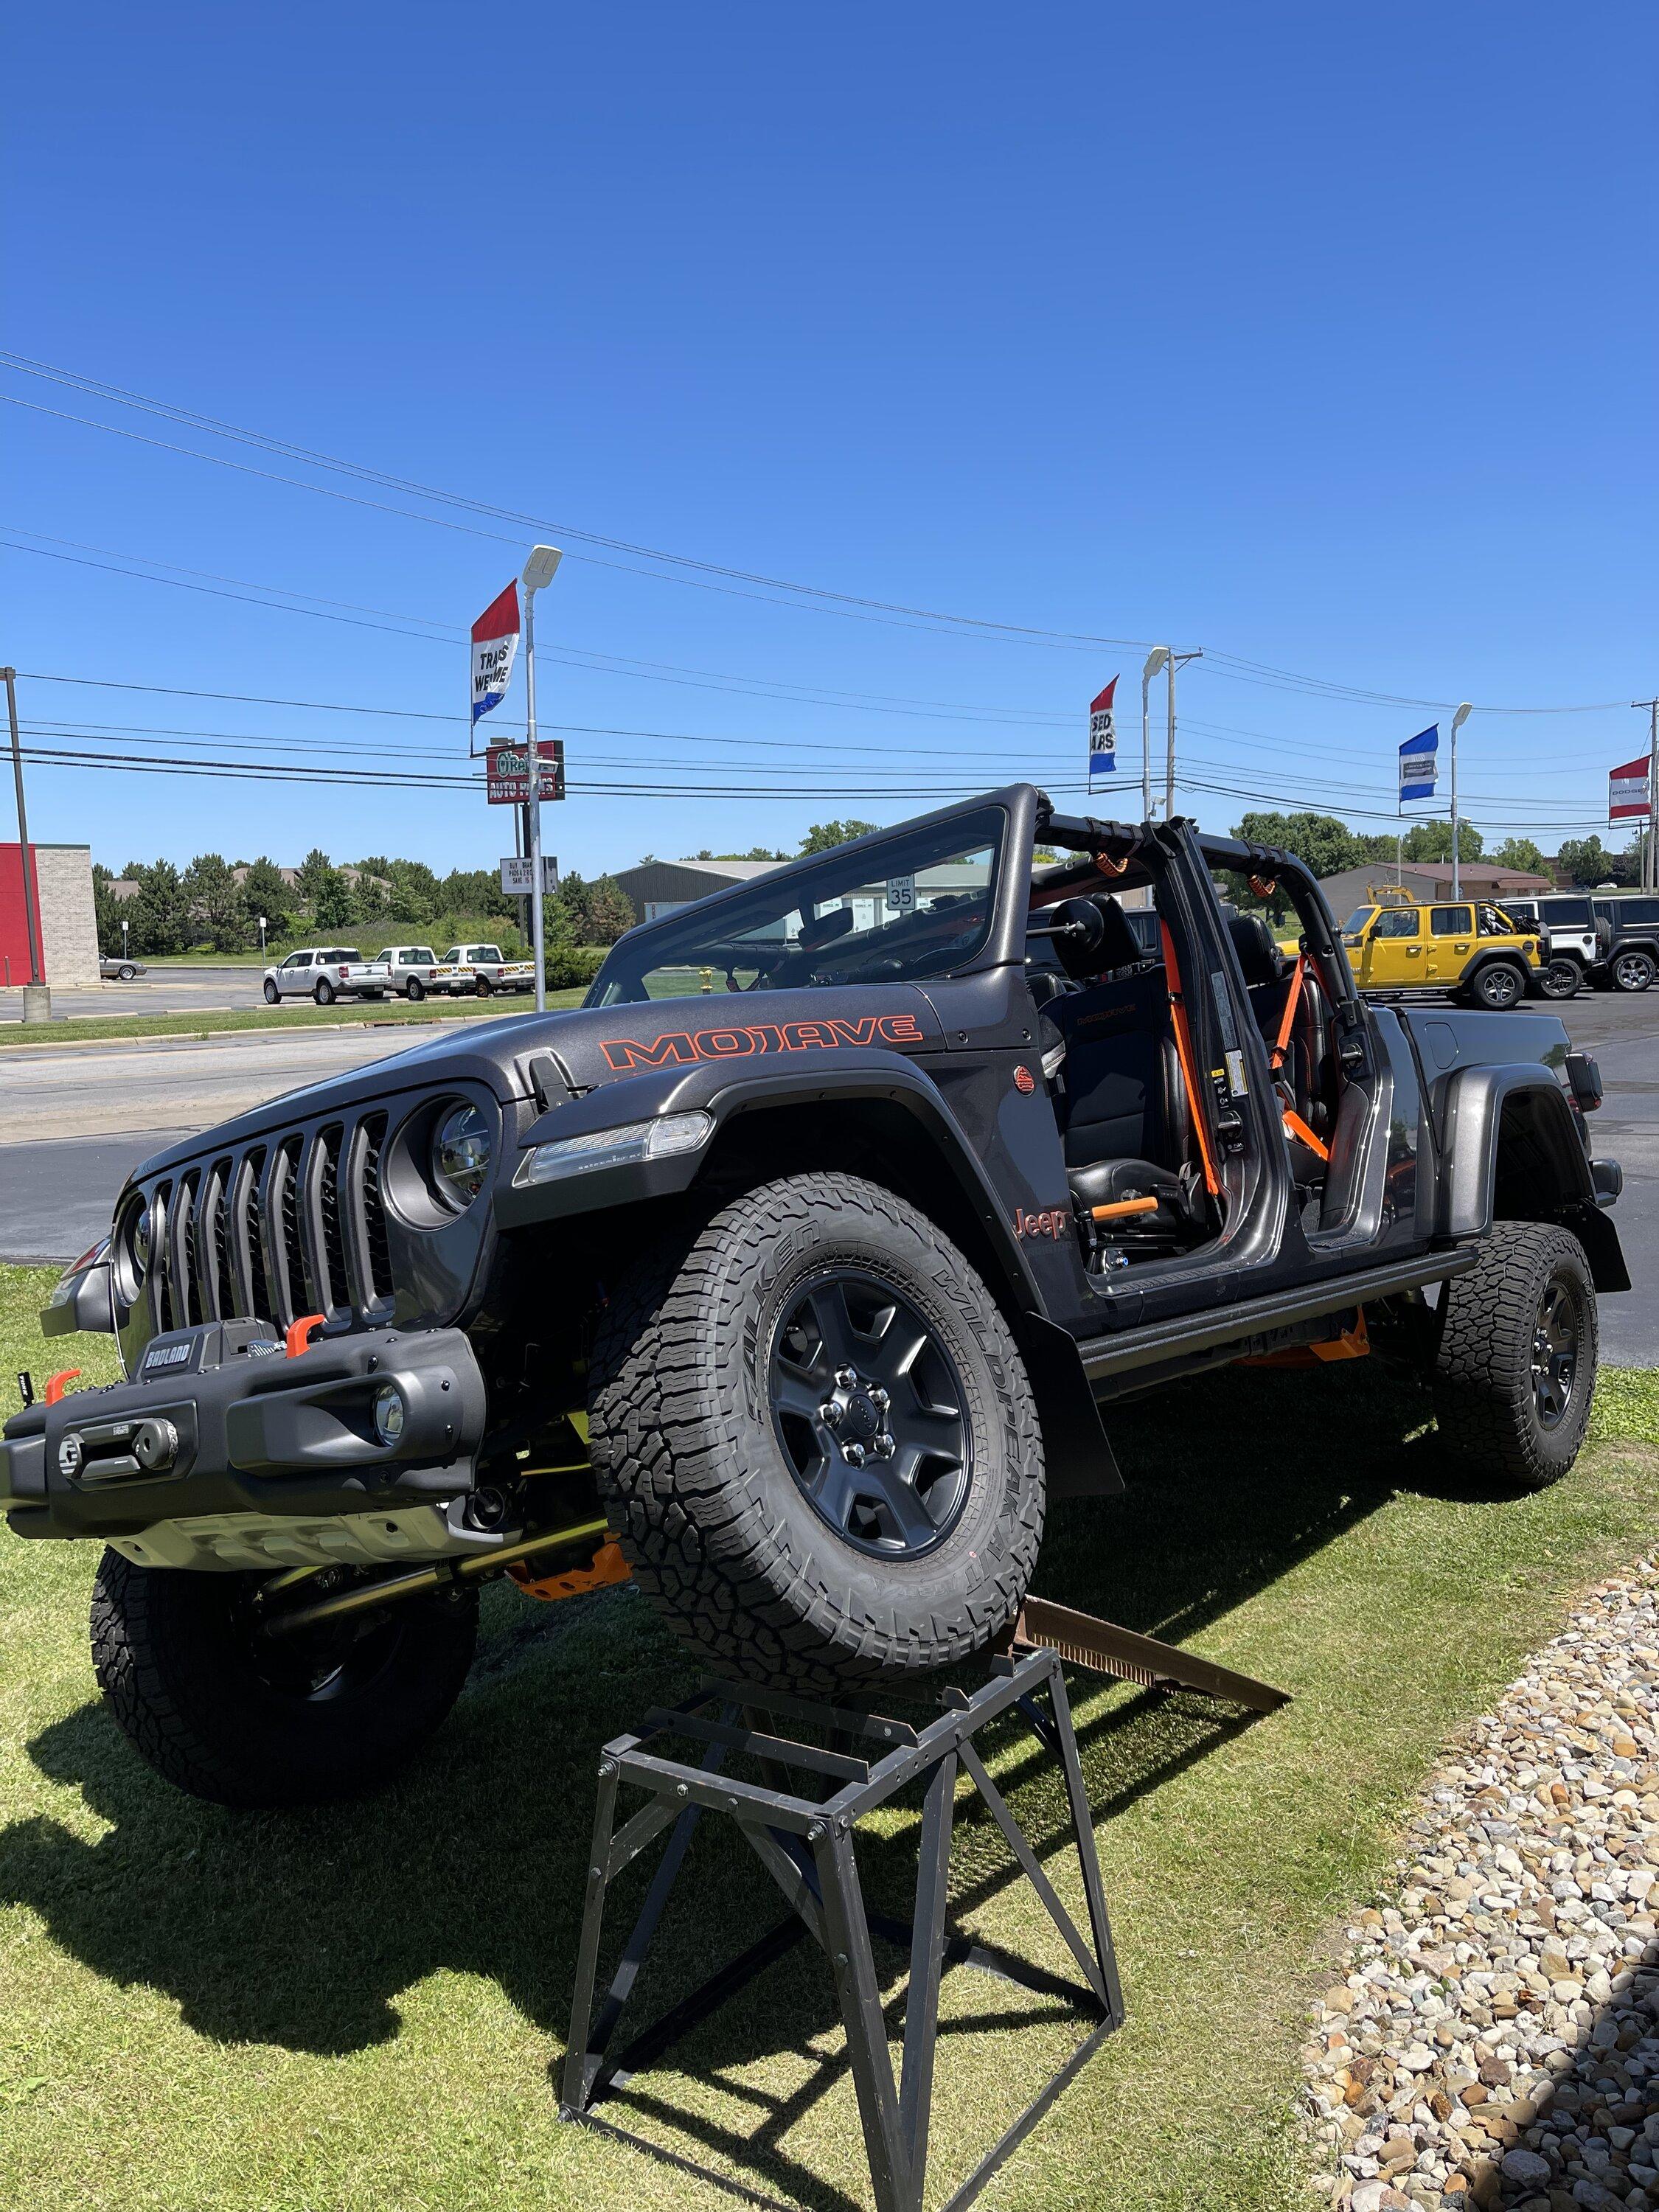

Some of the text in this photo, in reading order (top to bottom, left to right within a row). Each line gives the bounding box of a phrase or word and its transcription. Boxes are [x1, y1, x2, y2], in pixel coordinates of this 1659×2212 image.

[480, 644, 509, 669] TRAS
[475, 667, 509, 692] WEME
[1091, 713, 1111, 731] SED
[1091, 733, 1114, 751] ARS
[497, 752, 529, 777] O'Re
[490, 782, 517, 798] AUTO
[891, 888, 911, 905] 35
[600, 1015, 924, 1071] MOJAVE
[1015, 1208, 1066, 1240] Jeep
[145, 1344, 189, 1368] BADLAND
[931, 1269, 1021, 1533] WILDPEAK
